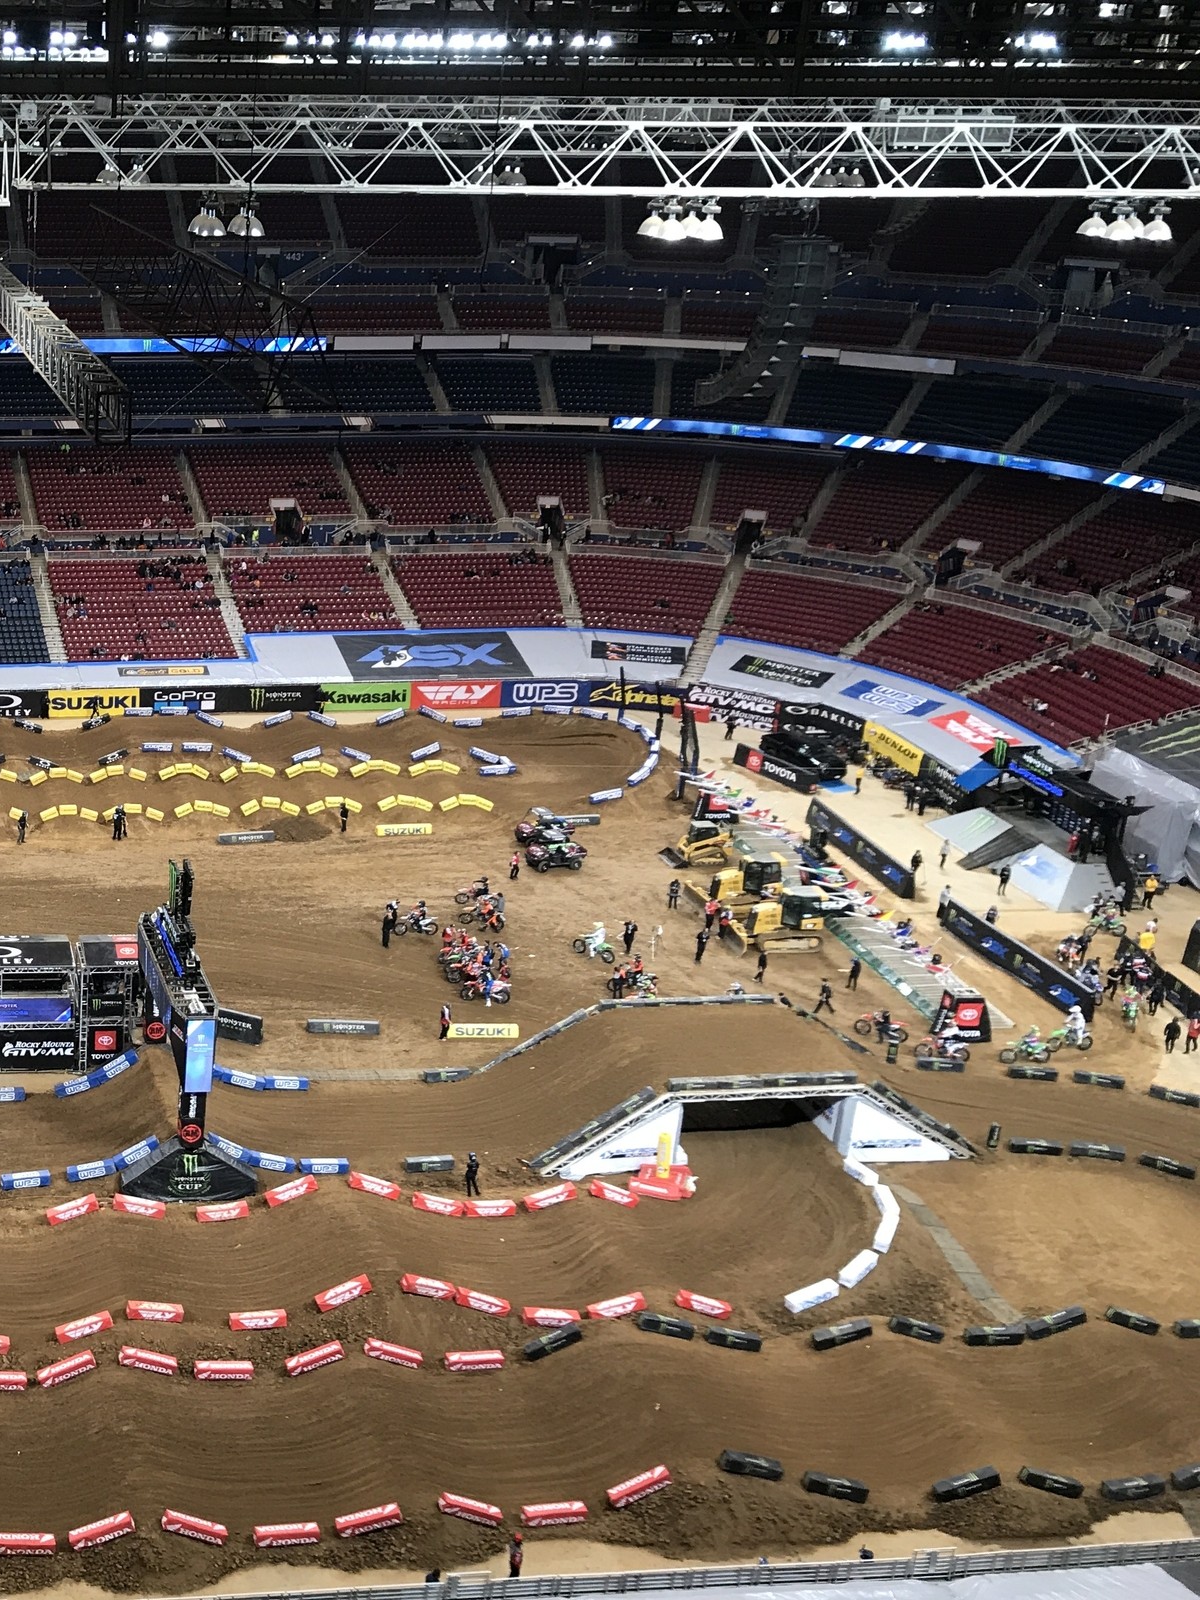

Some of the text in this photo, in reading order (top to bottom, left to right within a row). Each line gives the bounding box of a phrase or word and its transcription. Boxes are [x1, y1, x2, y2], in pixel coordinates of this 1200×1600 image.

[154, 690, 216, 701] GoPro
[326, 690, 407, 704] Kawasaki
[417, 684, 497, 700] FLY
[513, 683, 578, 703] WPS
[704, 686, 777, 706] ROCKY MOUNTAIN
[729, 708, 774, 724] MOUNTAIN
[810, 708, 863, 732] OAKLEY
[877, 732, 918, 760] DUNLOP
[763, 760, 797, 783] TOYOTA
[384, 826, 427, 836] SUZUKI
[332, 1023, 366, 1031] MONSTER
[455, 1026, 511, 1036] SUZUKI
[231, 1075, 256, 1089] WPS
[274, 1078, 300, 1089] WPS
[259, 1159, 287, 1170] WPS
[312, 1163, 340, 1174] WPS
[78, 1168, 106, 1178] WPS
[13, 1178, 40, 1188] WPS
[178, 1182, 203, 1190] CUP
[53, 1364, 95, 1382] HONDA
[133, 1362, 174, 1374] HONDA
[208, 1372, 252, 1380] HONDA
[86, 1528, 131, 1548] HONDA
[179, 1528, 224, 1545] HONDA
[272, 1536, 318, 1546] HONDA
